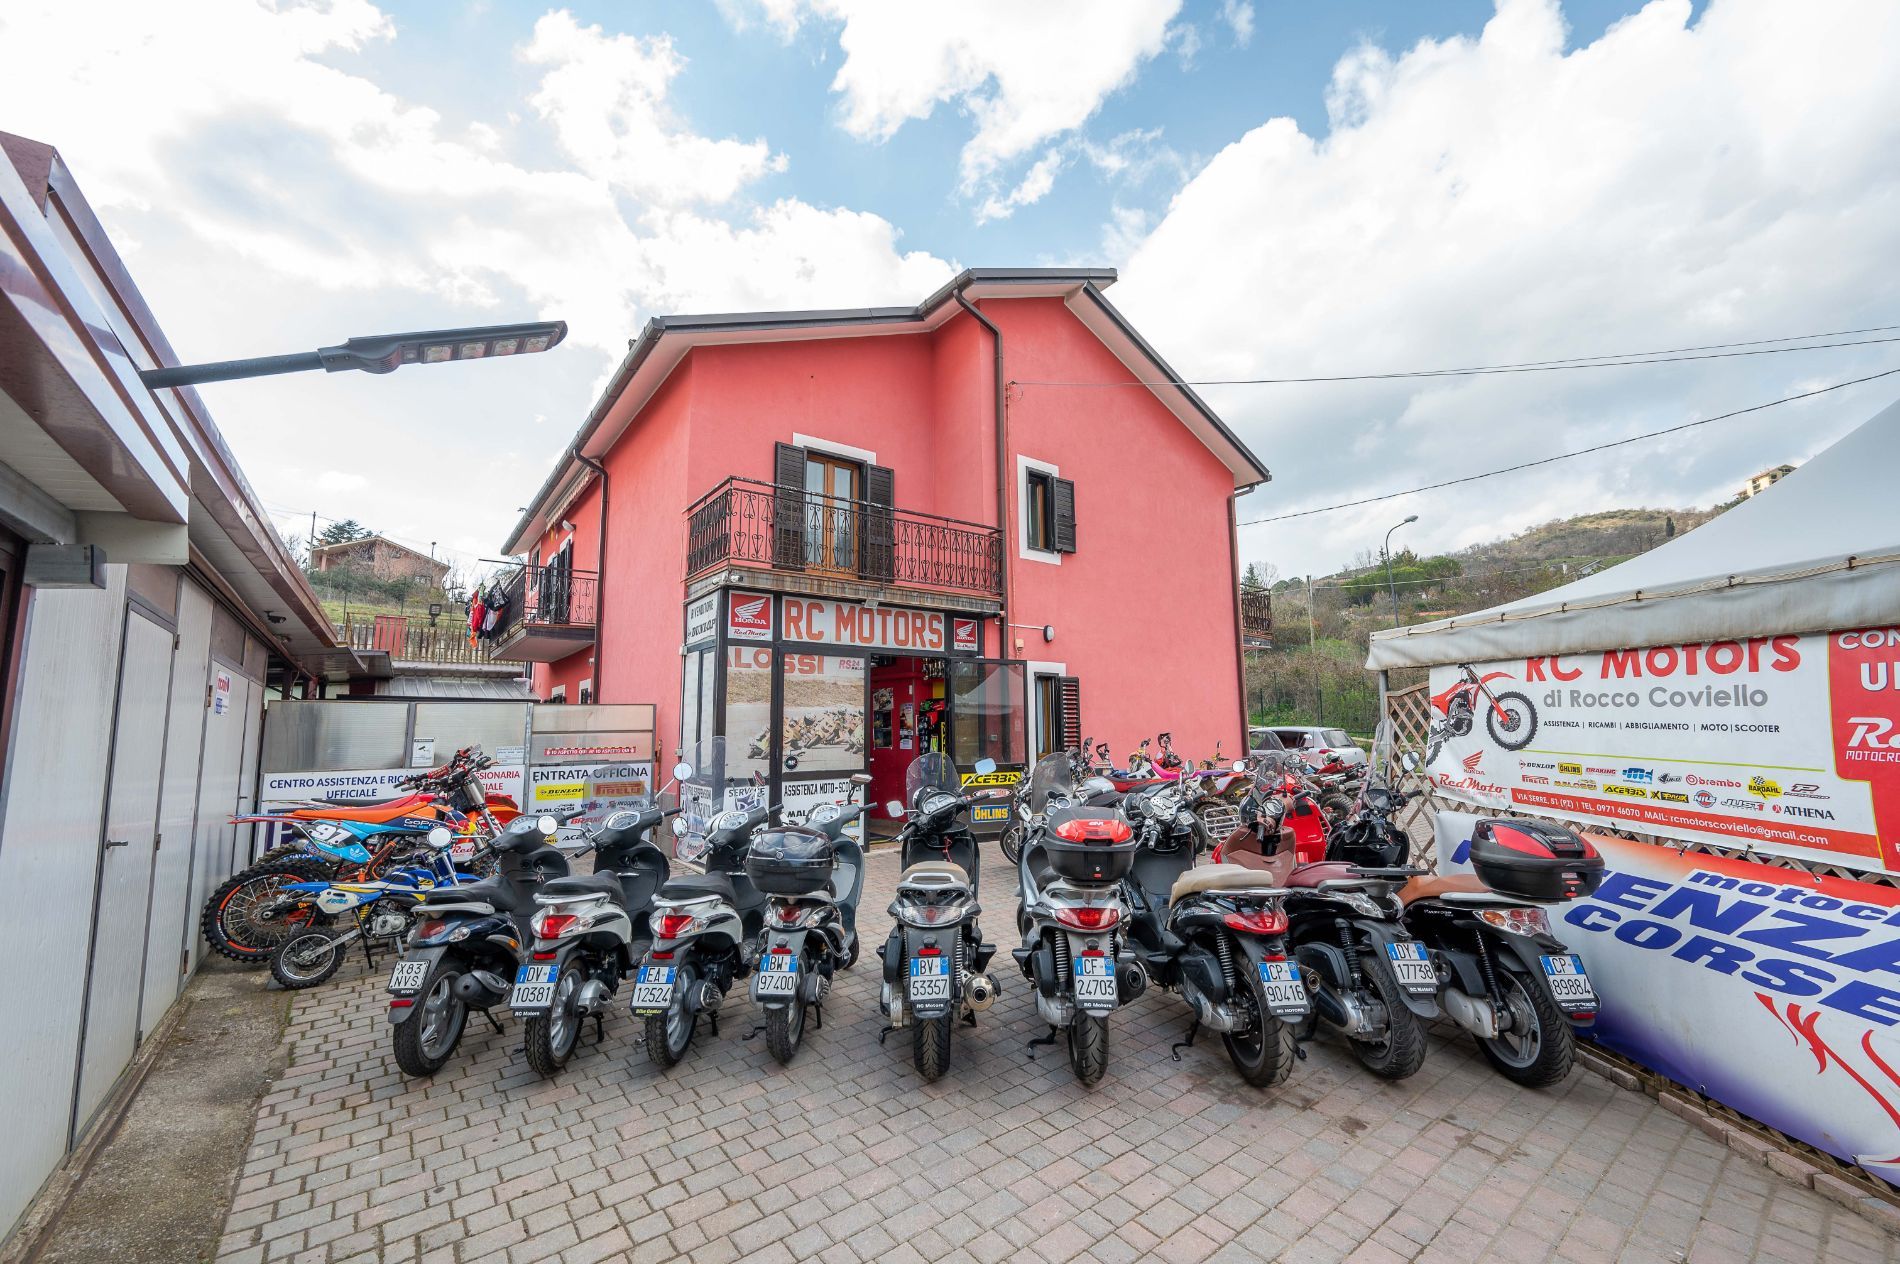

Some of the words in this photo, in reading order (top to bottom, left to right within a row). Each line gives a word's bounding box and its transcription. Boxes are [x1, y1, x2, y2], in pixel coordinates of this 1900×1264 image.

[735, 617, 767, 625] HONDA
[784, 599, 825, 641] RC
[835, 604, 943, 649] MOTORS
[1526, 655, 1583, 682] RC
[1543, 689, 1562, 708] di
[1570, 689, 1640, 708] Rocco
[1648, 684, 1769, 708] Coviello
[1543, 720, 1580, 729] ASSISTENZA
[1588, 720, 1617, 730] RICAMBI
[1625, 721, 1690, 731] ABBIGLIAMENTO
[1701, 723, 1729, 732] MOTO
[1735, 724, 1780, 733] SCOOTER
[270, 779, 315, 789] CENTRO
[317, 775, 377, 787] ASSISTENZA
[380, 775, 386, 785] E
[533, 769, 589, 781] ENTRATA
[593, 767, 649, 779] OFFICINA
[1526, 762, 1556, 770] DUNLOP
[1699, 777, 1742, 788] brembo
[1748, 784, 1781, 795] BARDAHL
[326, 788, 378, 800] UFFICIALE
[547, 787, 584, 795] DUNLOP
[784, 784, 818, 797] ASSISTENZA
[1604, 786, 1647, 797] ACERBIS
[1784, 805, 1836, 821] ATHENA
[974, 806, 1009, 821] ÖHLINS
[1516, 792, 1528, 801] VIA
[1581, 802, 1596, 812] TEL.
[1596, 804, 1615, 814] 0971
[1617, 807, 1640, 818] 46070
[1644, 810, 1669, 822] MAIL:
[1670, 815, 1829, 846] rcmotorscoviello@gmail.com
[312, 824, 353, 845] 97
[1396, 944, 1411, 959] DY
[398, 964, 422, 975] X83
[770, 957, 783, 971] BW
[920, 959, 934, 975] BV
[1083, 959, 1098, 975] CF
[1397, 963, 1433, 980] 17738
[1552, 958, 1567, 974] CP
[1563, 904, 1900, 1027] CORSE
[526, 967, 543, 982] DV
[647, 968, 660, 983] EA
[1269, 965, 1283, 980] CP
[394, 975, 419, 987] NVS
[760, 976, 794, 991] 97400
[912, 979, 948, 996] 53357
[1078, 980, 1115, 996] 24703
[1554, 979, 1591, 996] 89884
[514, 986, 550, 1003] 10381
[637, 987, 671, 1003] 12524
[1267, 985, 1304, 1002] 90416
